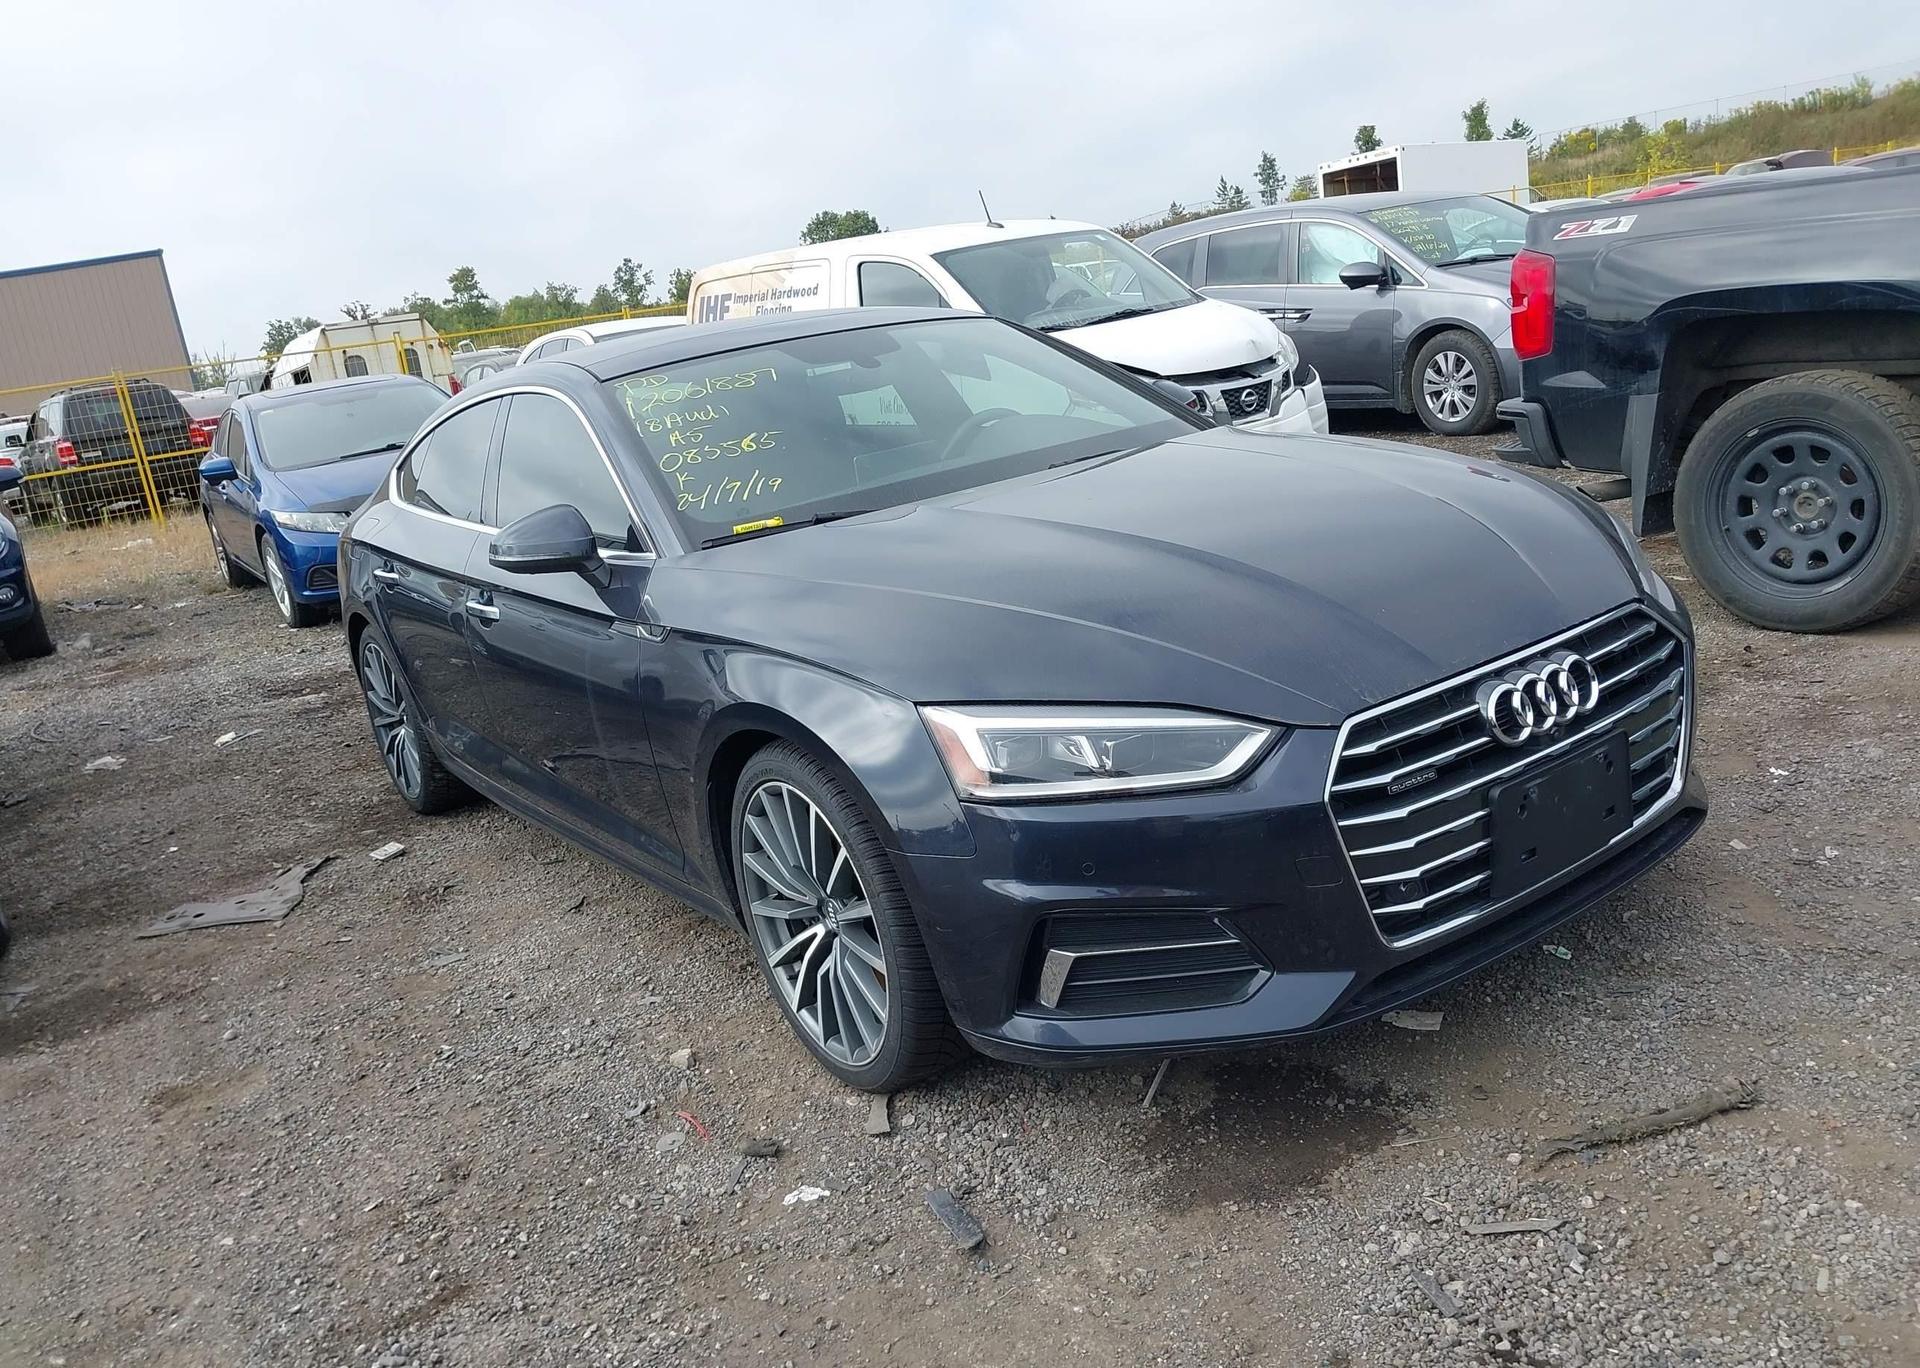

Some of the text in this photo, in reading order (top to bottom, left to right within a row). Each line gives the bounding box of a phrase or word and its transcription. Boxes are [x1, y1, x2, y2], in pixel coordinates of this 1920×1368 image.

[1552, 214, 1639, 241] Z71
[733, 283, 819, 305] Imperial Hardwood
[699, 293, 732, 324] IHF
[675, 471, 696, 490] K
[1391, 771, 1436, 792] quattro
